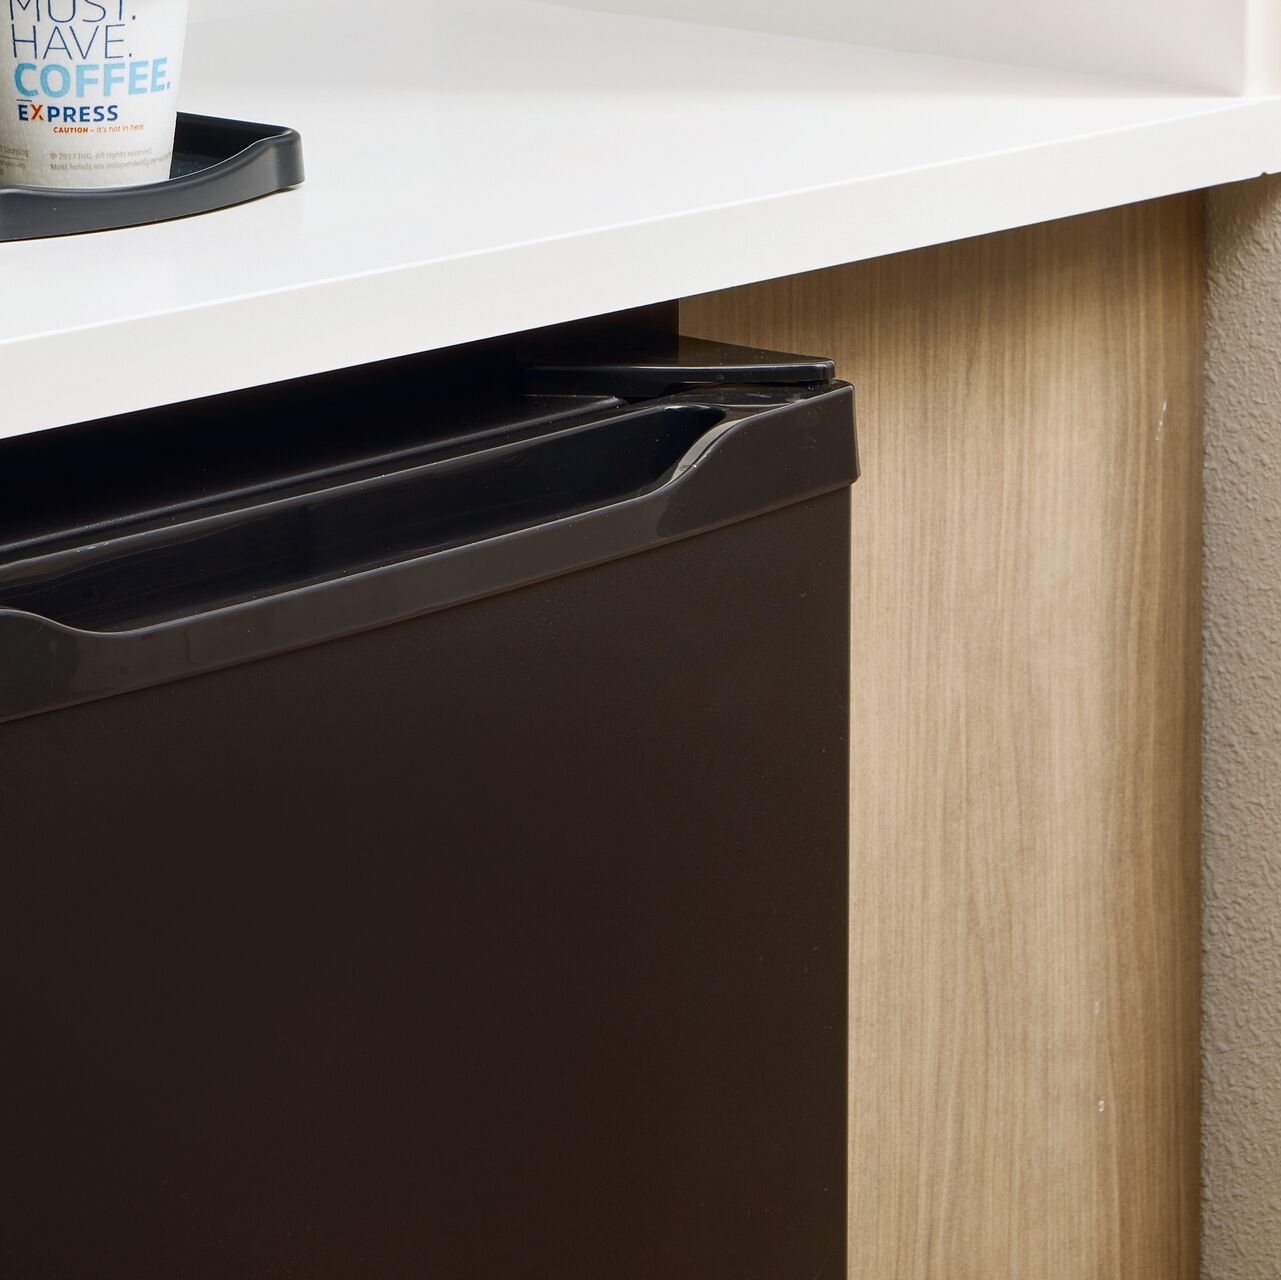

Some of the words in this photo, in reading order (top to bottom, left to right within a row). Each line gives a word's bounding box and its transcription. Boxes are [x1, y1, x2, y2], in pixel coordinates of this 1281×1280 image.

[11, 23, 132, 60] HAVE.
[14, 57, 171, 98] COFFEE.
[18, 104, 118, 123] EXPRESS
[53, 126, 89, 134] CAUTION
